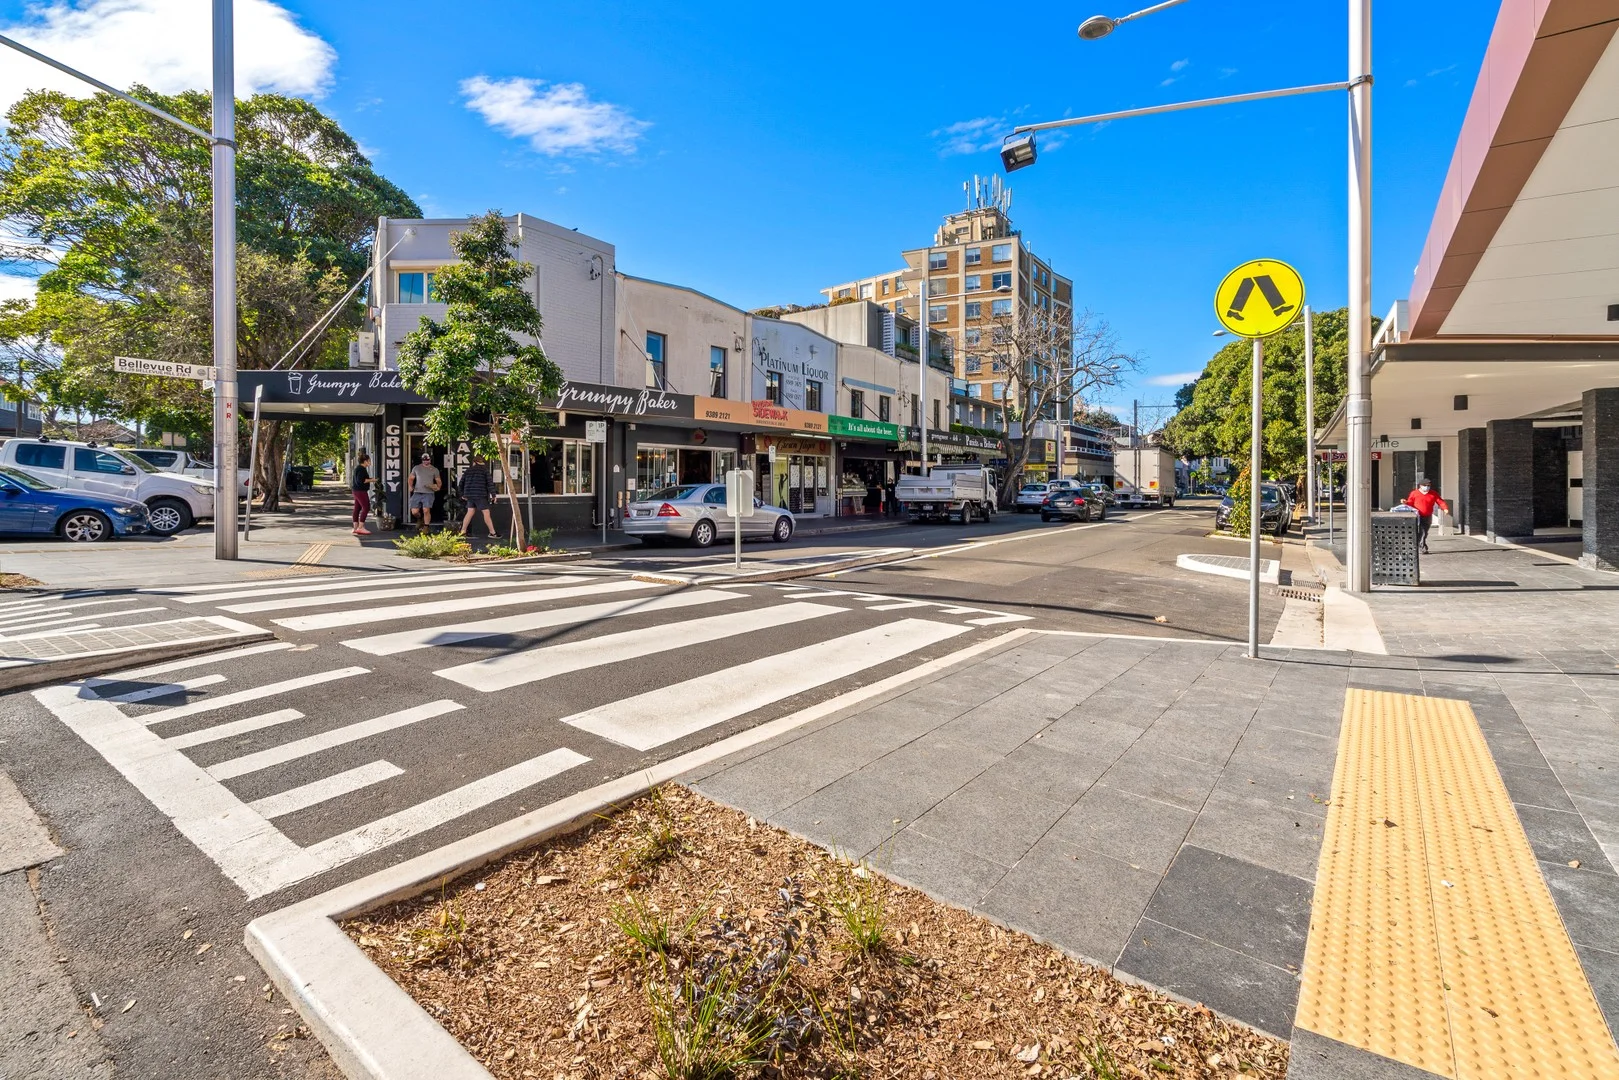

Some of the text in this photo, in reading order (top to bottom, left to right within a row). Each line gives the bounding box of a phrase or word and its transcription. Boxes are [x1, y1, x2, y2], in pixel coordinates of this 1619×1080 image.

[118, 358, 192, 375] Bellevue Rd
[306, 374, 362, 396] Grumpy
[555, 381, 678, 416] Grumpy Baker
[705, 410, 731, 419] 9389 2121
[863, 425, 876, 433] about
[386, 424, 400, 492] GRUMPY
